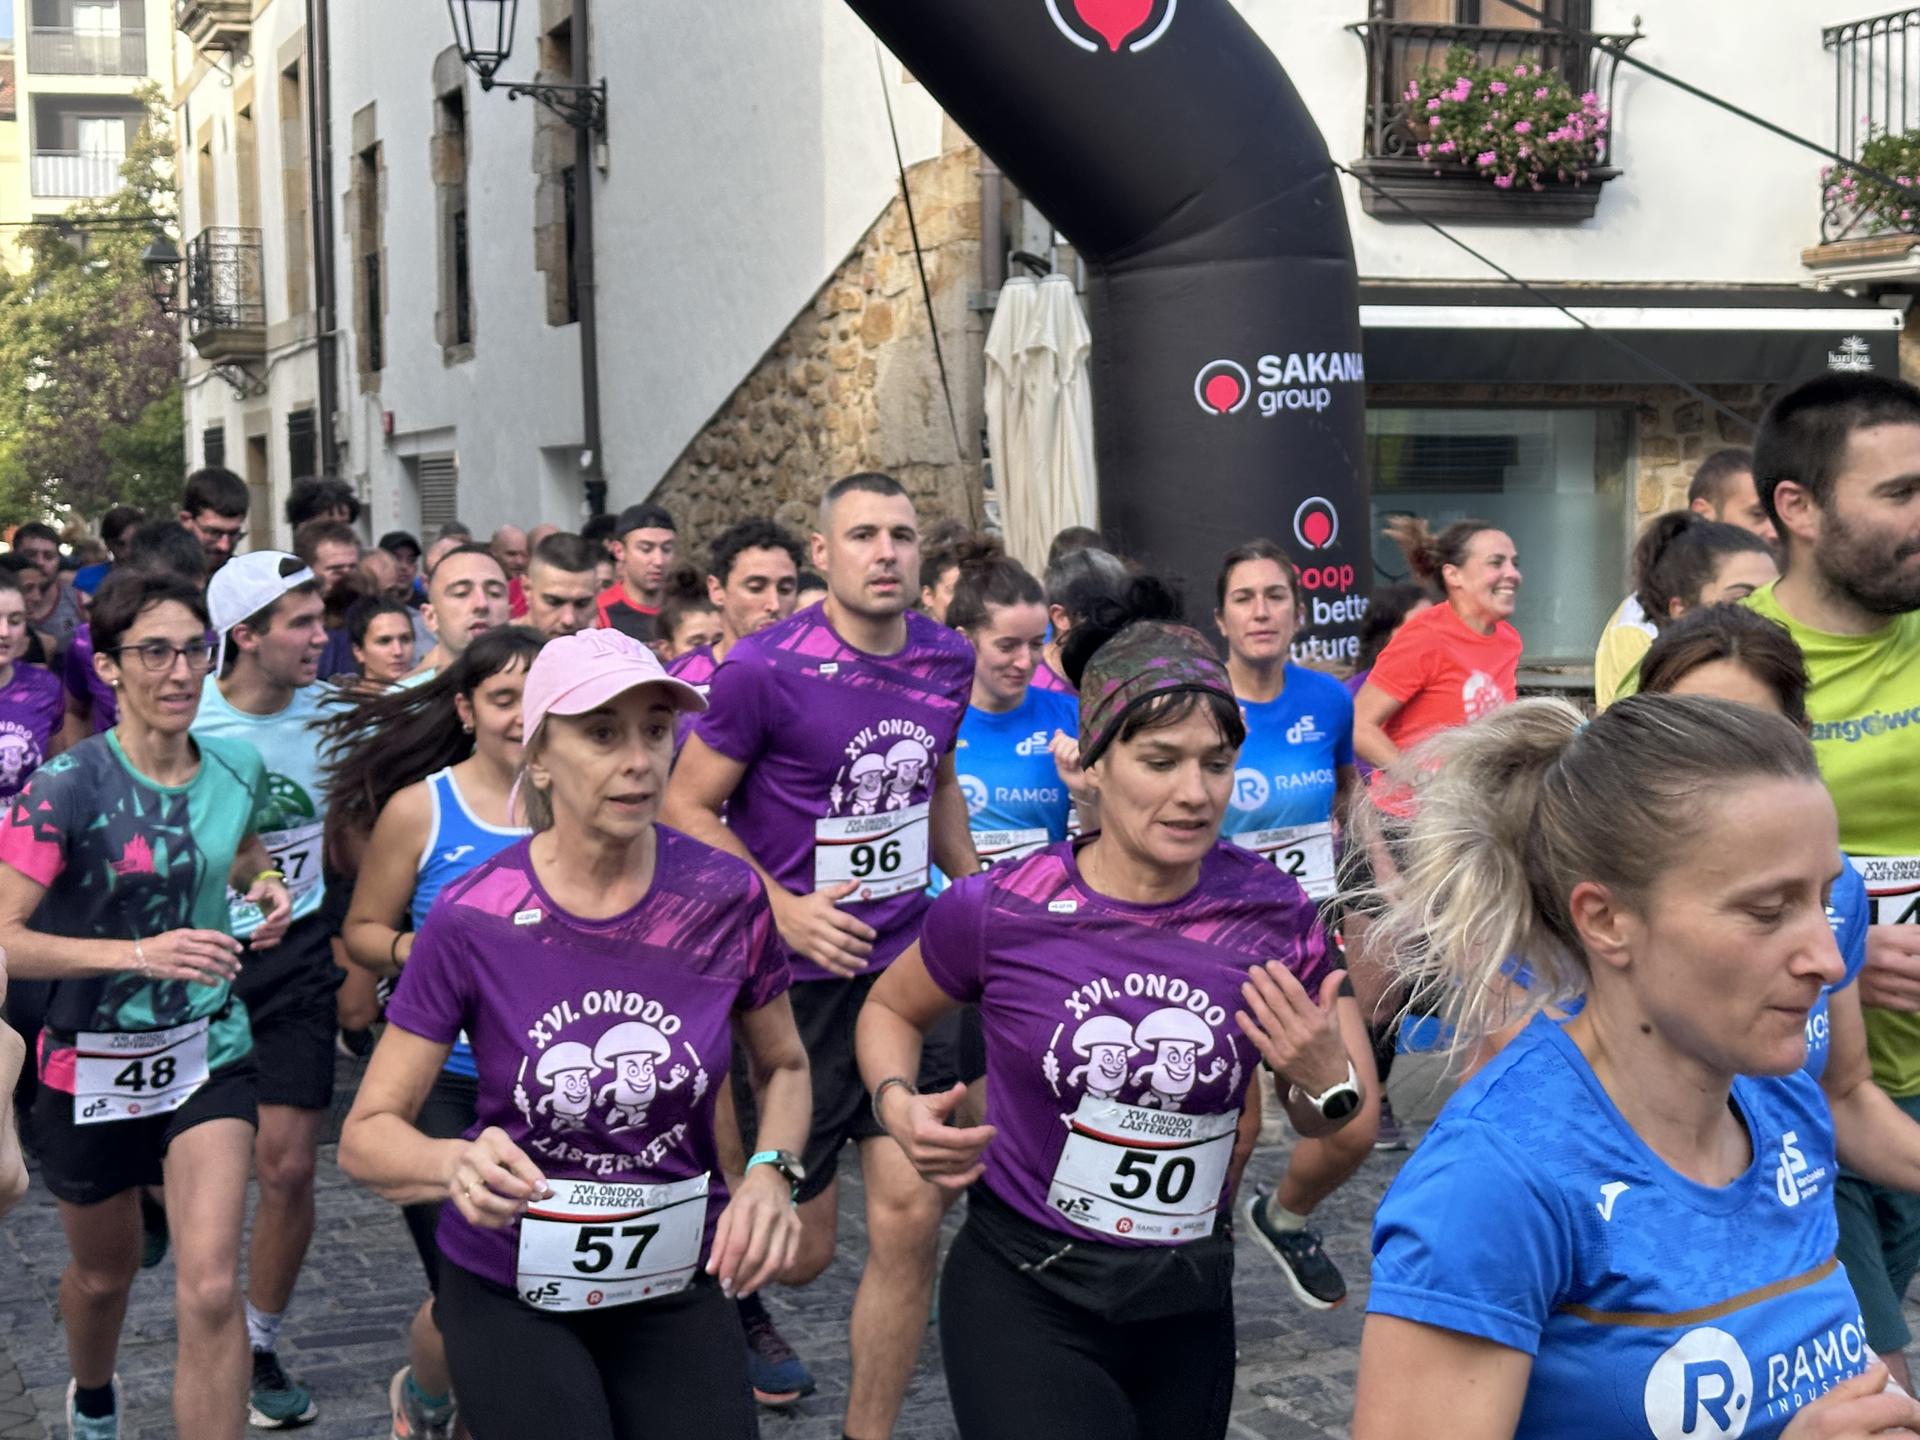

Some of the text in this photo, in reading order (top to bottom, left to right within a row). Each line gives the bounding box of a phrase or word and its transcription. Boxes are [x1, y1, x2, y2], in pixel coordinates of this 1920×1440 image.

[1258, 388, 1331, 417] group
[1290, 635, 1360, 663] uture
[845, 719, 936, 760] XVI. ONDDO
[995, 786, 1059, 803] RAMOS
[1275, 768, 1333, 791] RAMOS
[850, 840, 901, 877] 96
[1064, 972, 1226, 1026] XVI. ONDDO
[528, 989, 682, 1049] XVI. ONDDO
[114, 1056, 177, 1092] 48
[1119, 1119, 1192, 1139] LASTERKETA
[1151, 1113, 1192, 1128] ONDDO
[531, 1122, 687, 1176] LASTERKETA
[600, 1186, 643, 1198] ONDDO
[1109, 1149, 1196, 1204] 50
[568, 1195, 645, 1208] LASTERKETA
[572, 1223, 661, 1274] 57
